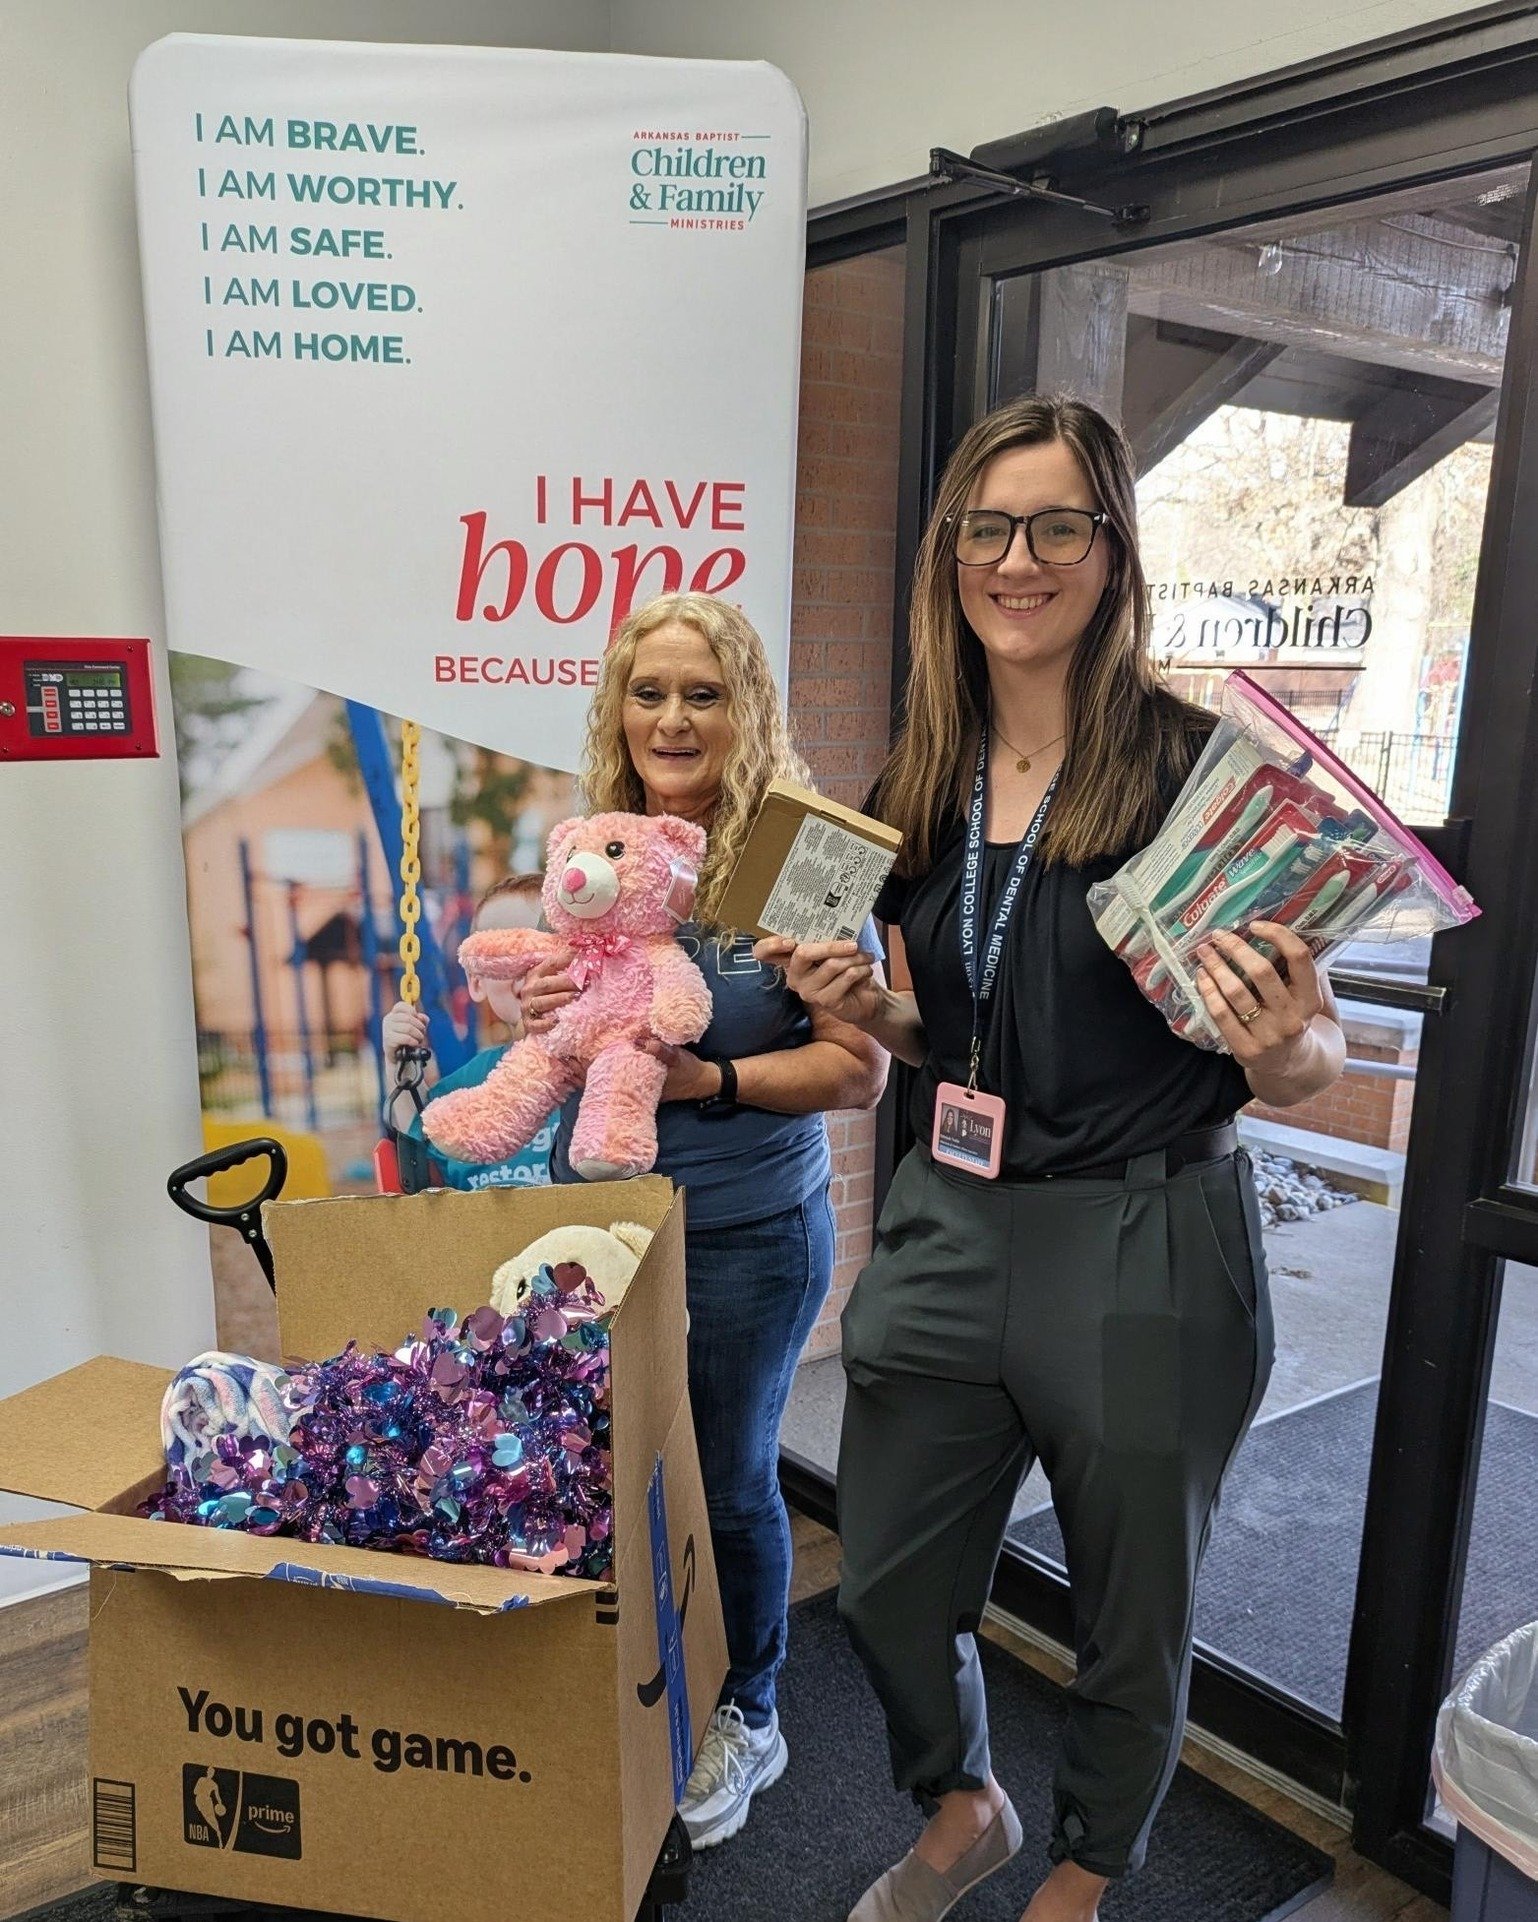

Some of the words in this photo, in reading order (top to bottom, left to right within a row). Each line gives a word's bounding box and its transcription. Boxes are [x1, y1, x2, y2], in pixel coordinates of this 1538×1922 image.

[195, 112, 203, 142] I
[215, 115, 274, 147] AM
[287, 120, 425, 155] BRAVE.
[633, 131, 690, 141] ARKANSAS
[695, 132, 740, 142] BAPTIST
[631, 147, 767, 179] Children
[198, 167, 206, 197] I
[217, 169, 276, 201] AM
[286, 173, 464, 210] WORTHY.
[629, 183, 653, 211] &
[657, 181, 765, 222] Family
[201, 222, 209, 251] I
[220, 223, 278, 254] AM
[289, 227, 393, 260] SAFE.
[670, 218, 744, 231] MINISTRIES
[204, 276, 212, 305] I
[222, 277, 280, 307] AM
[292, 279, 423, 314] LOVED.
[206, 329, 214, 357] I
[225, 330, 282, 359] AM
[294, 332, 411, 365] HOME.
[536, 475, 547, 524] I
[572, 477, 746, 532] HAVE
[434, 655, 600, 687] BECAUSE
[974, 774, 985, 791] OF
[969, 793, 984, 849] SCHOOL
[1022, 795, 1051, 852] SCHOOL
[963, 851, 979, 915] COLLEGE
[1015, 855, 1029, 875] OF
[994, 877, 1021, 931] DENTAL
[962, 918, 974, 955] LYON
[980, 933, 1003, 1000] MEDICINE
[969, 1119, 992, 1139] Lyon
[177, 1686, 264, 1744] You
[274, 1713, 362, 1759] got
[371, 1728, 533, 1784] game.
[189, 1823, 210, 1842] NBA
[248, 1804, 295, 1824] prime
